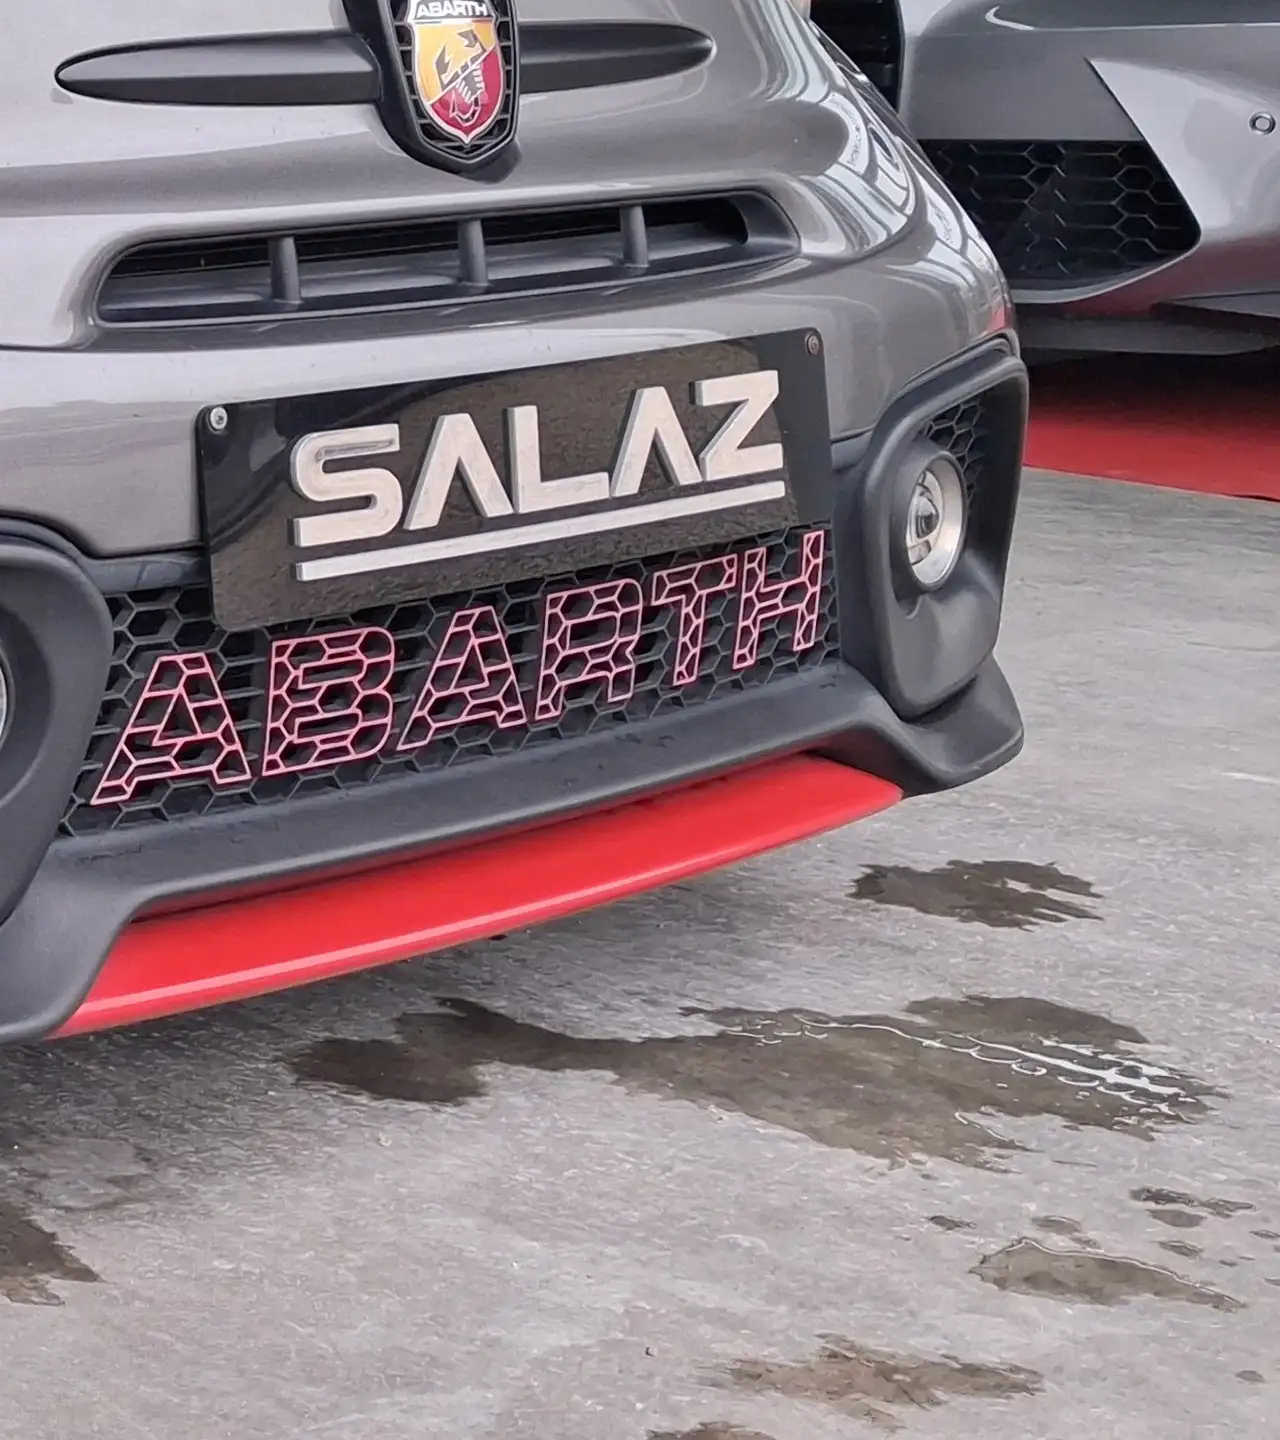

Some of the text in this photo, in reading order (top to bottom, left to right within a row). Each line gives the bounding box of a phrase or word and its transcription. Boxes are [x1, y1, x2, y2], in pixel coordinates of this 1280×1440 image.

[416, 0, 488, 18] ABARTH
[288, 370, 785, 548] SALAZ
[90, 530, 826, 807] ABARTH
